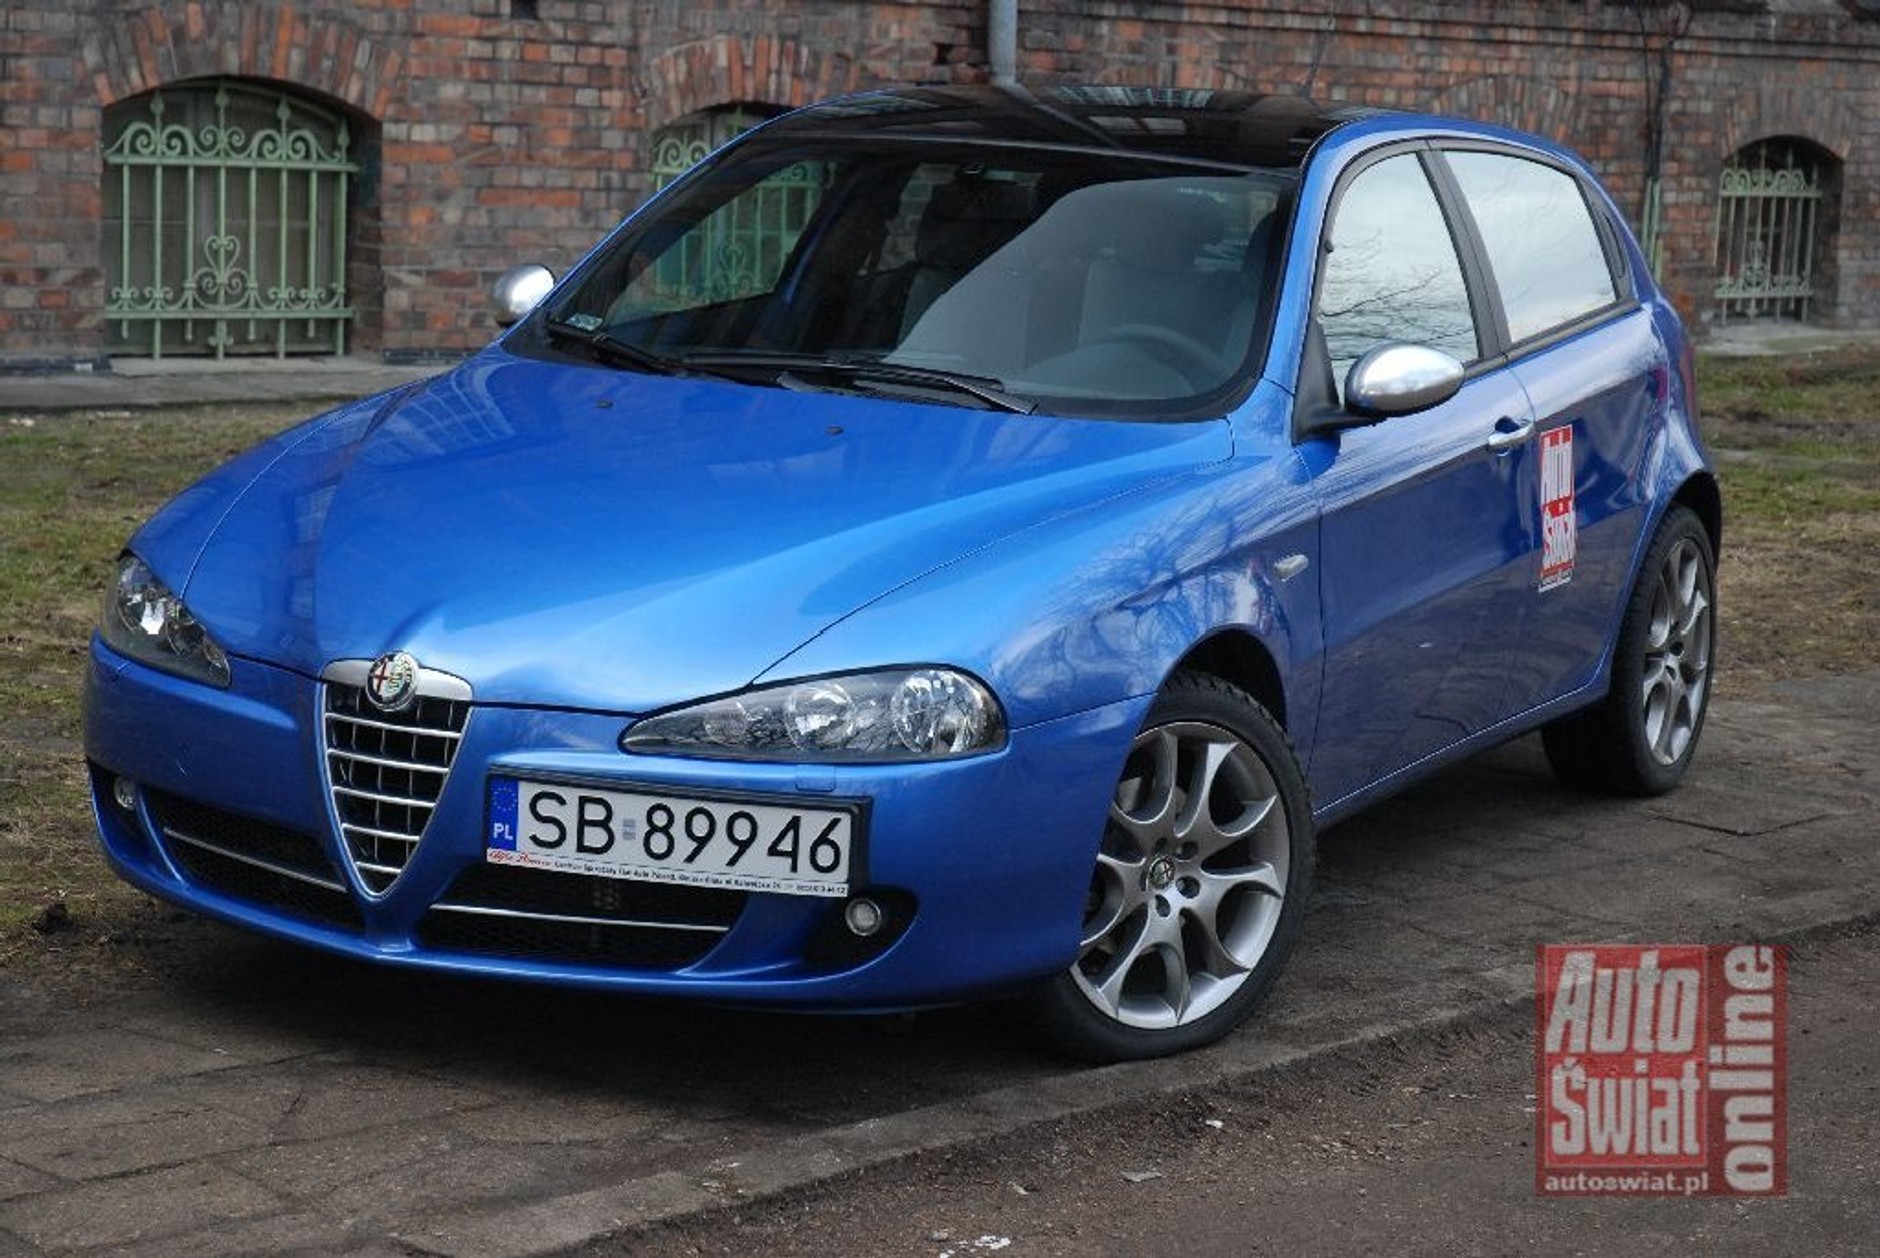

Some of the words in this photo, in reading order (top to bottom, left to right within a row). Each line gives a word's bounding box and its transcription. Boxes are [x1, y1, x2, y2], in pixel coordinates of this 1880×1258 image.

[493, 823, 514, 841] PL
[528, 791, 616, 855] SB
[642, 803, 842, 875] 89946
